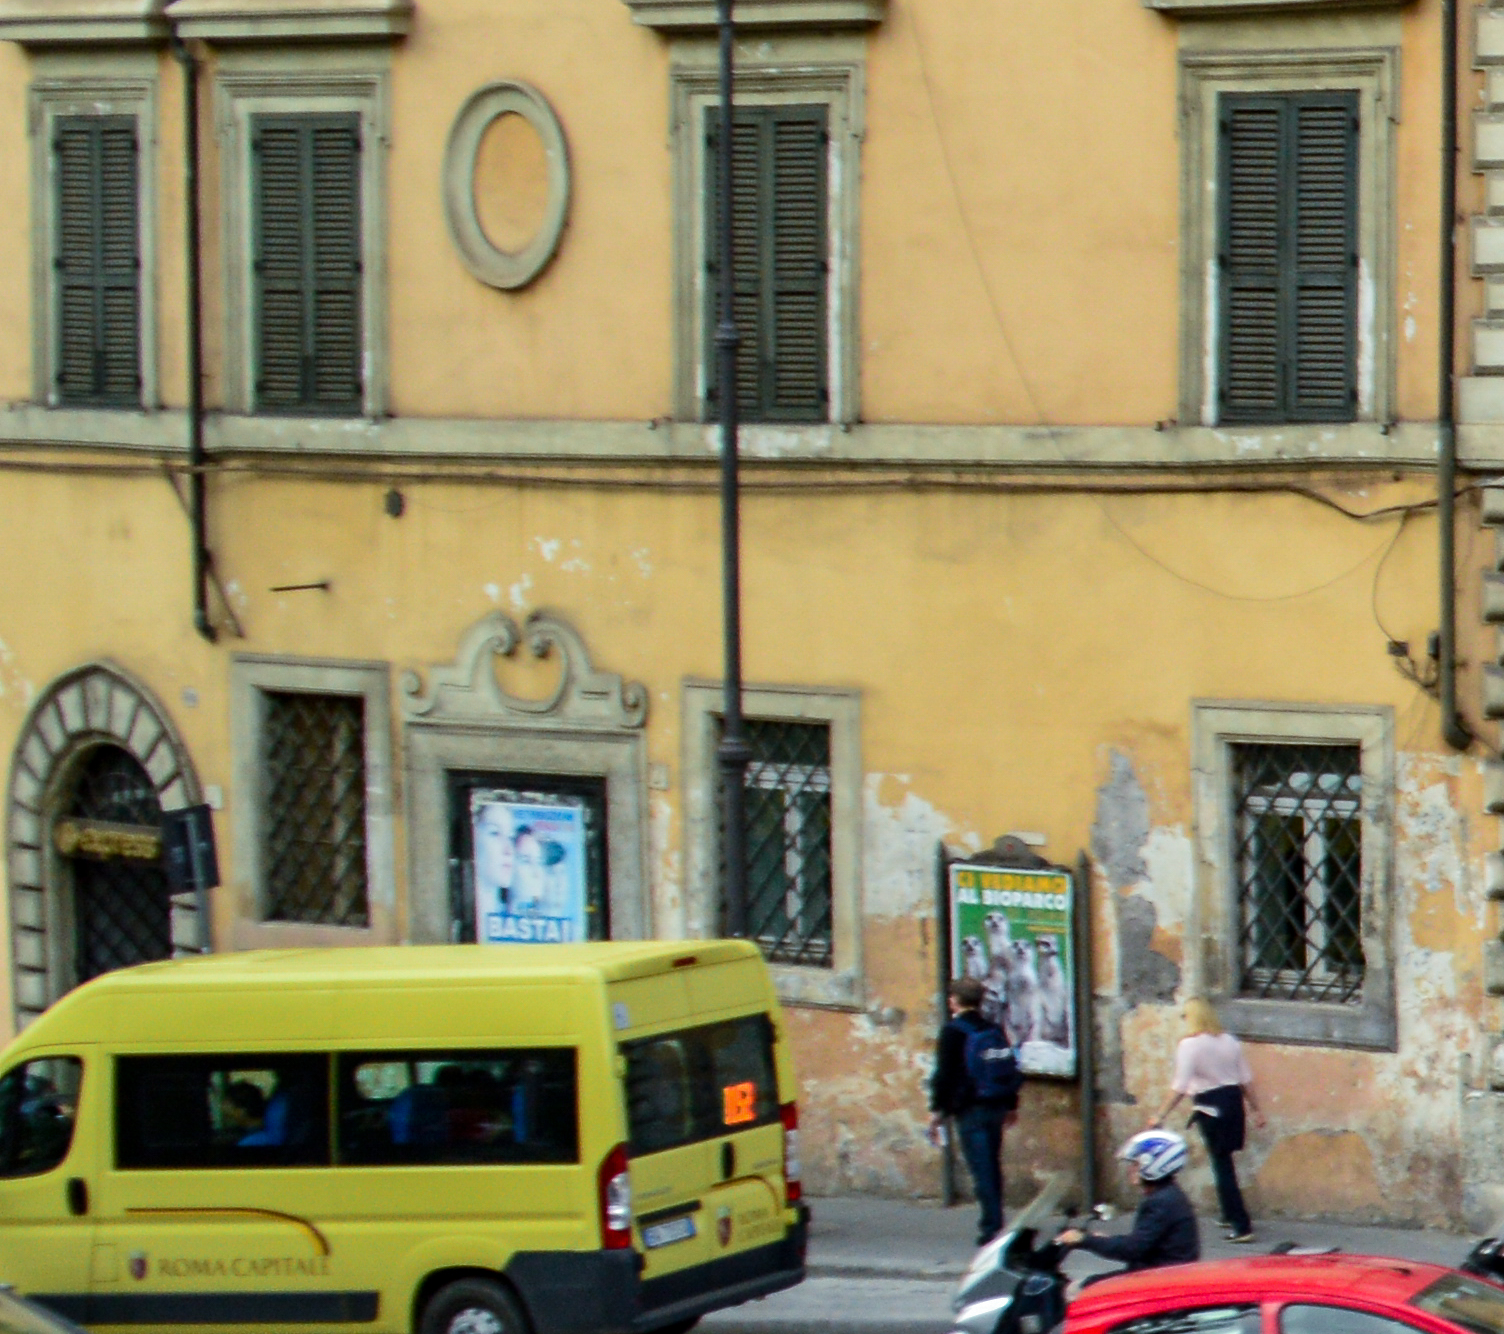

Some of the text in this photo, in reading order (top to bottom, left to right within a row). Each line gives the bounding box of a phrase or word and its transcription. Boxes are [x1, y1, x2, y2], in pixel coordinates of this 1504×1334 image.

[958, 888, 1067, 910] AL BIOPARCO
[157, 1257, 330, 1277] ROMA CAPITALE
